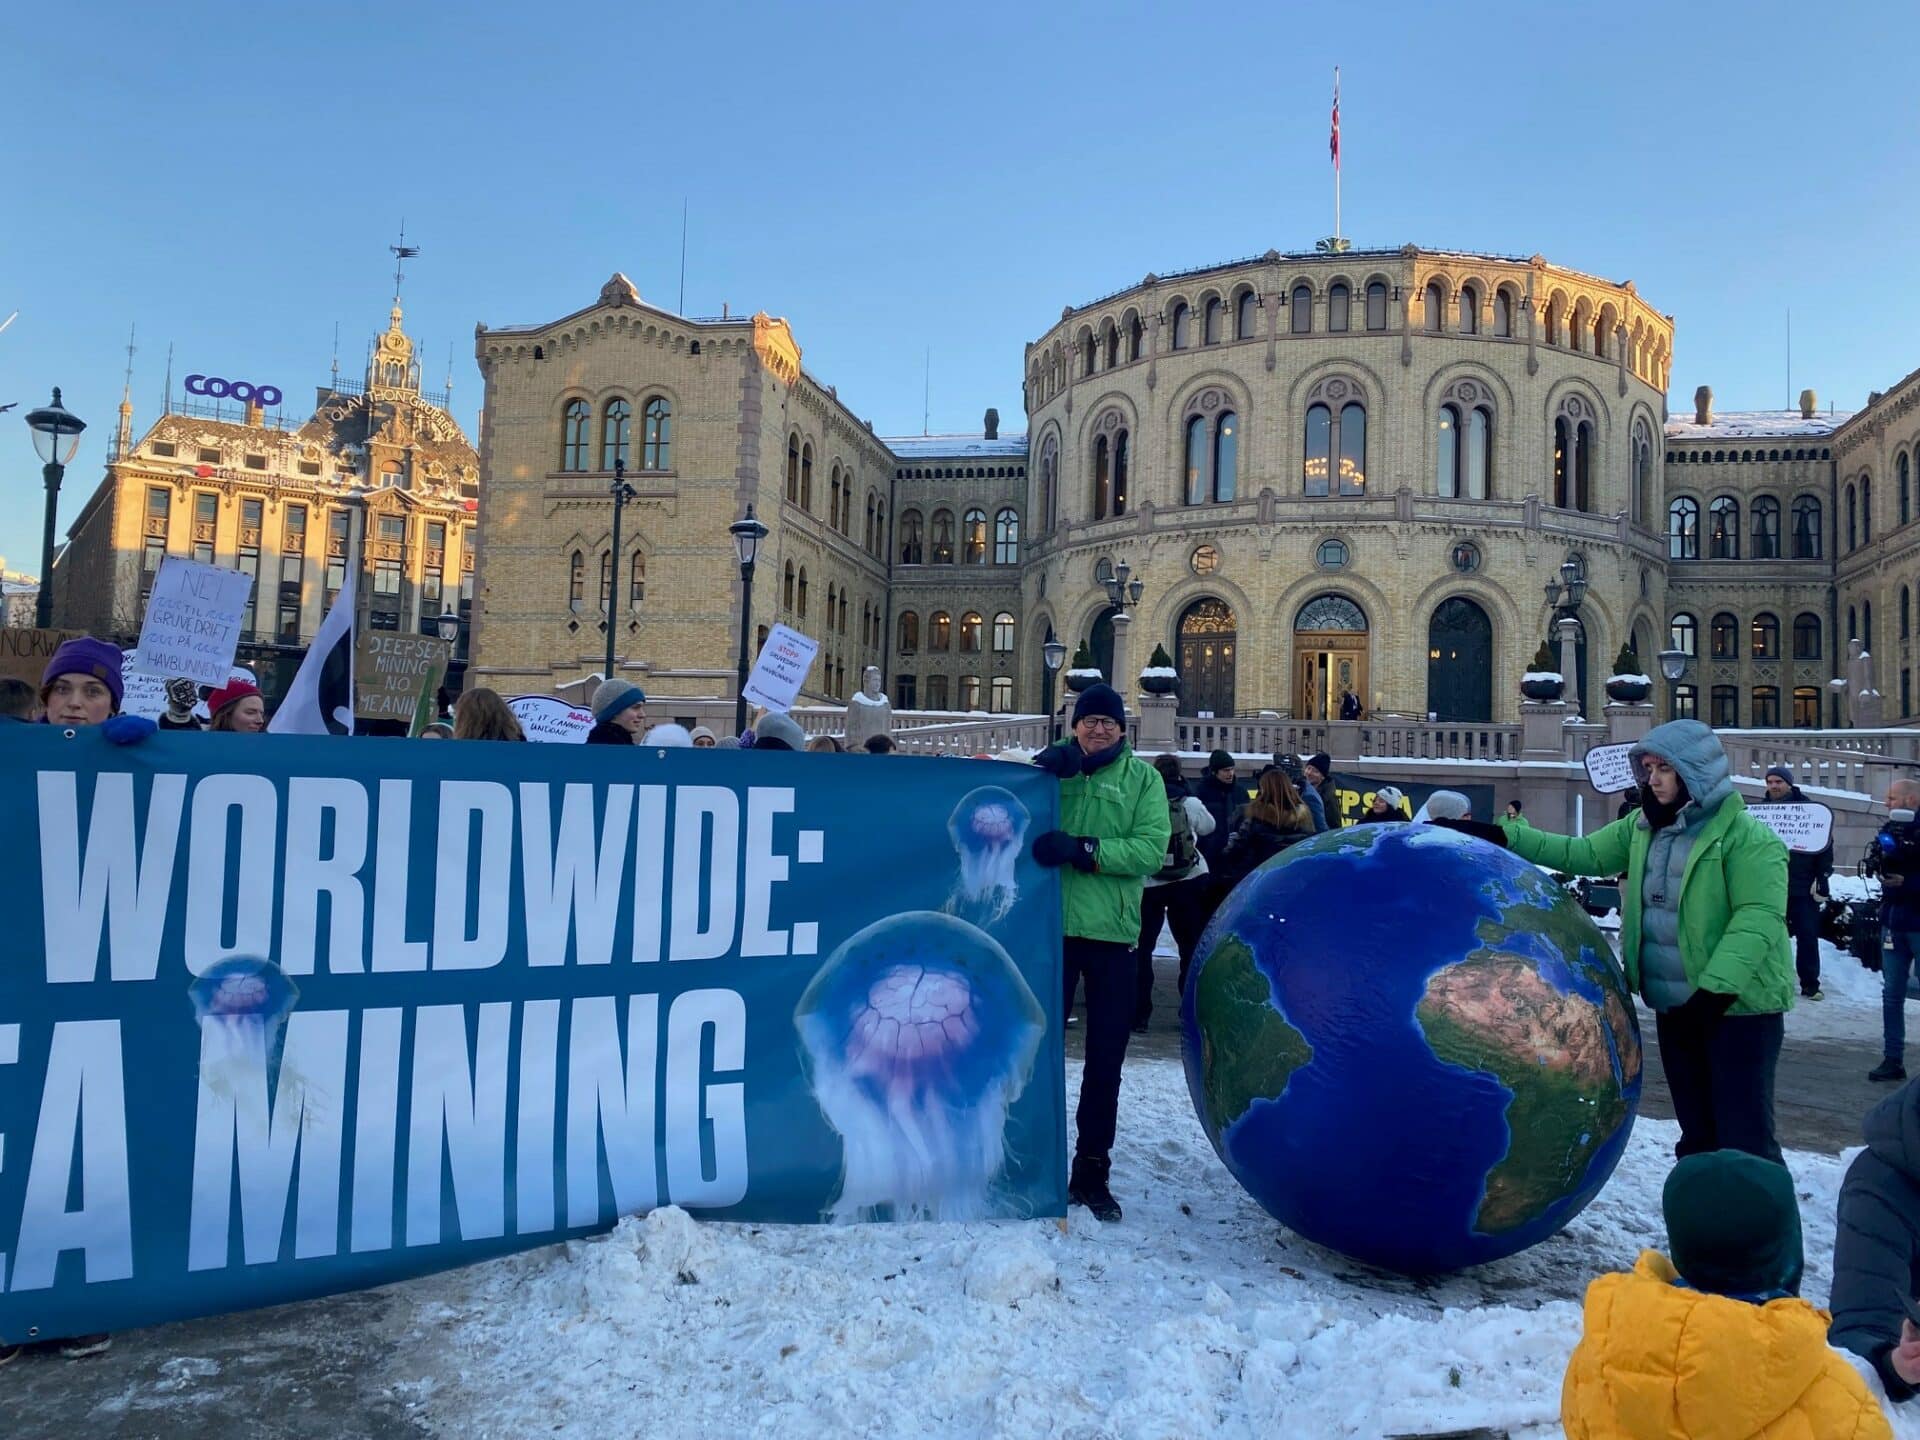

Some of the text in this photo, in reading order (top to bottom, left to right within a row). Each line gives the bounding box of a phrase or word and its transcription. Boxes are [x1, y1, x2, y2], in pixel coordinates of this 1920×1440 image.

[331, 389, 456, 438] OLAV THON GRUPPEN
[153, 610, 231, 643] GRUVEDRIFT
[147, 651, 223, 680] HAVBUNNEN
[385, 674, 411, 692] NO
[550, 717, 586, 732] CANNOT
[36, 770, 825, 984] WORLDWIDE:
[188, 988, 749, 1273] MINING
